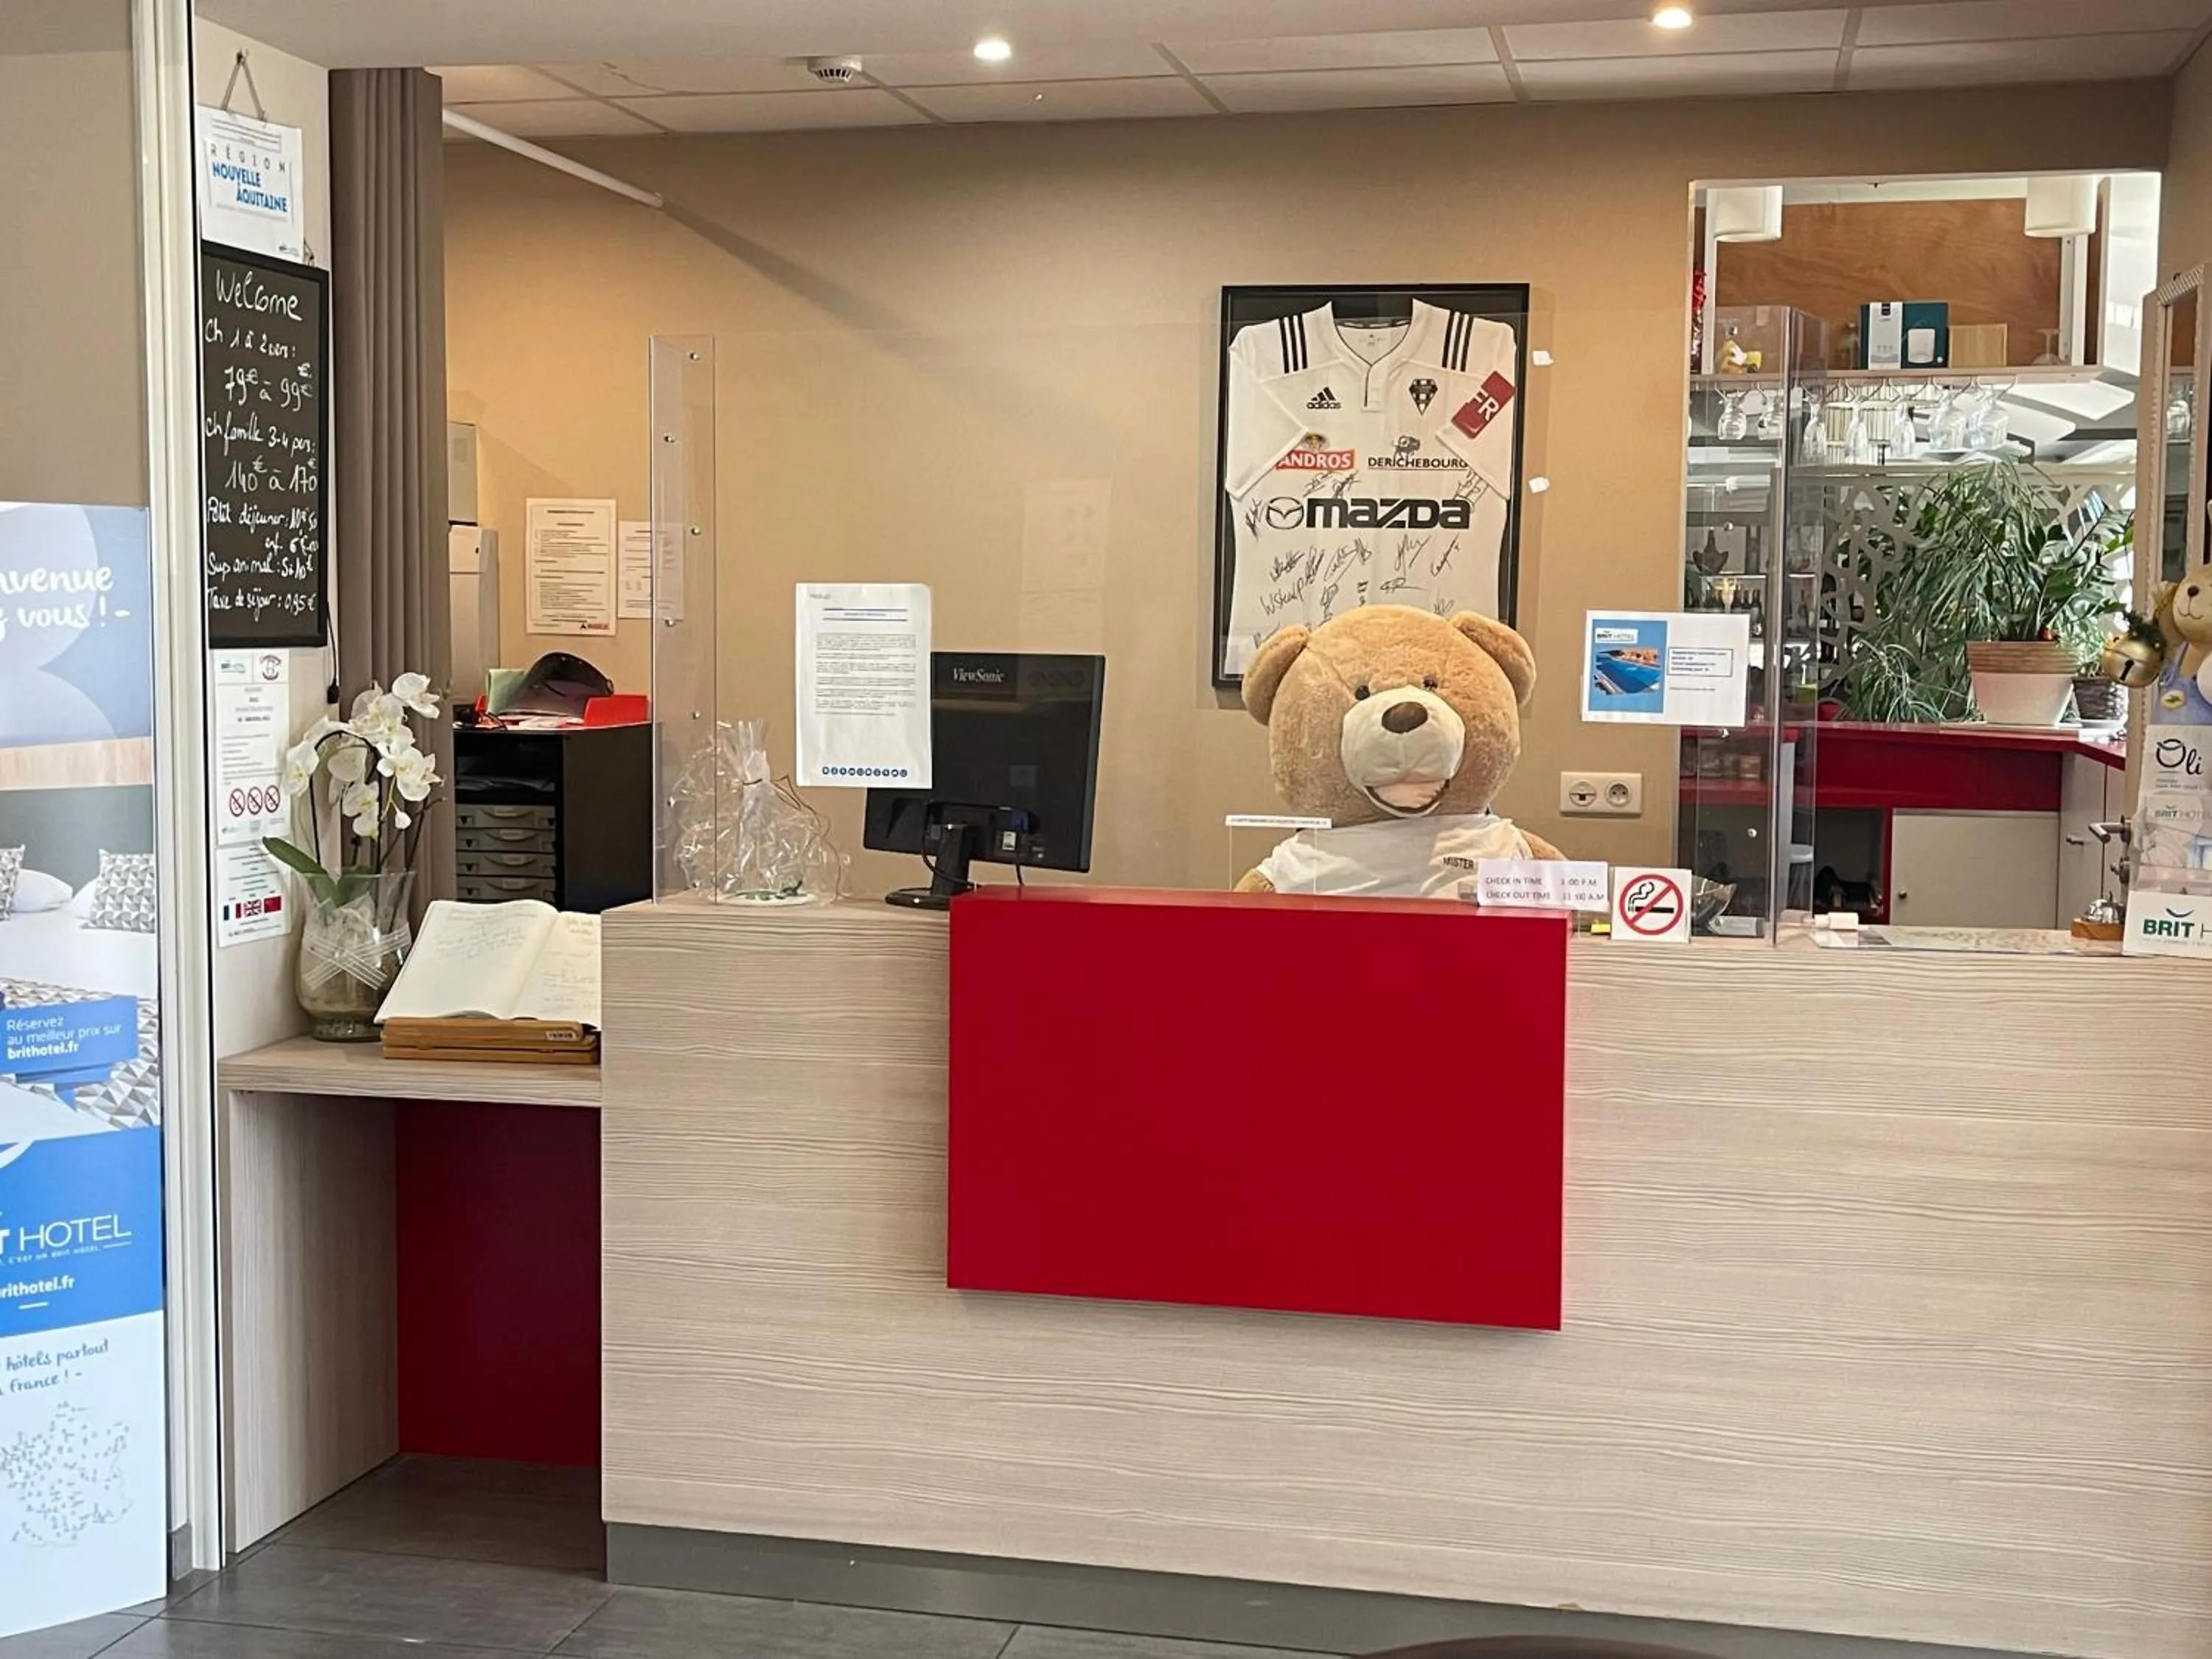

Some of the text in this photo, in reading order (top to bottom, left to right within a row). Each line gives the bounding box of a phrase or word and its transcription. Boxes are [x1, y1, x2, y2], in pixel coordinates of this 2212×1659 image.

[212, 161, 262, 188] NOUVELLE
[236, 188, 288, 212] AQUITAINE
[216, 268, 303, 321] Welcome
[1306, 401, 1341, 409] adidas
[1279, 453, 1352, 468] ANDROS
[17, 603, 90, 630] vous
[1443, 857, 1474, 870] MISTER
[2143, 919, 2195, 938] BRIT
[6, 1016, 64, 1032] Réservez
[7, 1024, 122, 1046] au meilleur prix sur
[7, 1040, 80, 1060] brithotel.fr
[20, 1214, 132, 1251] HOTEL
[0, 1275, 74, 1298] rithotel.fr
[57, 1338, 108, 1367] partout
